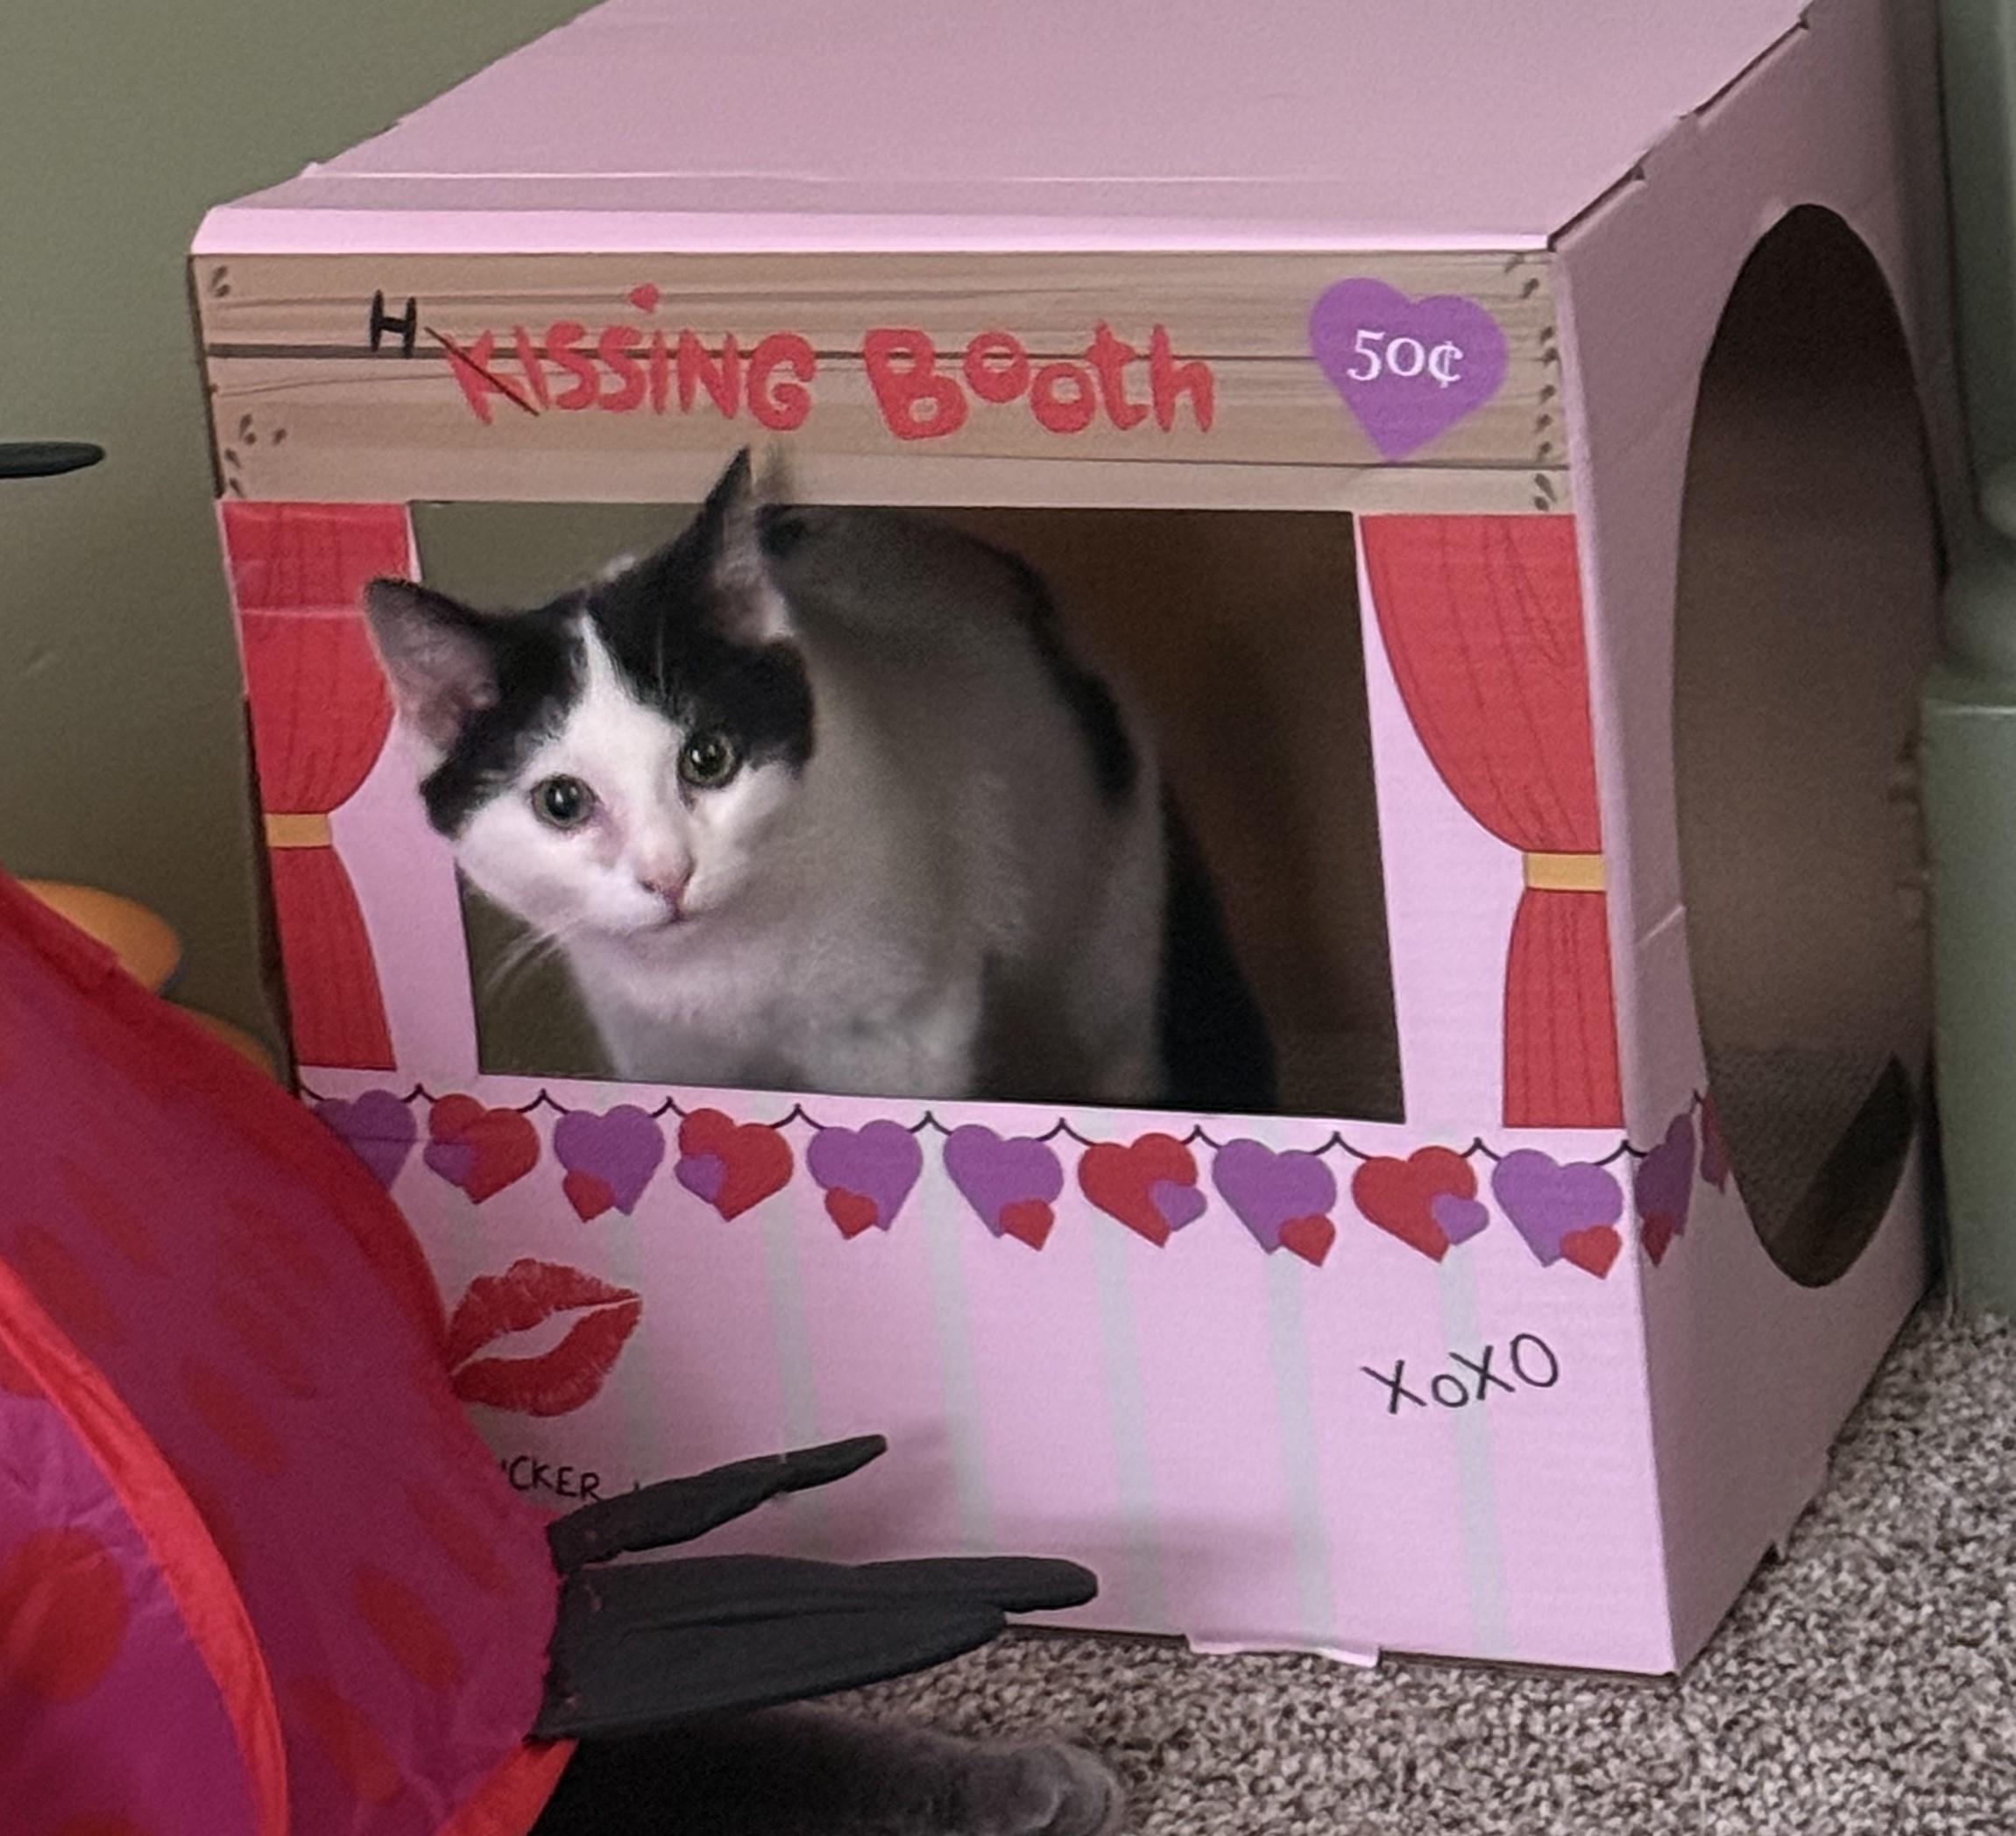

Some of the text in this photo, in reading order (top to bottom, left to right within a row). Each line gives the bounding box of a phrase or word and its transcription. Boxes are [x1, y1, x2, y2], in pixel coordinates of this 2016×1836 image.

[370, 288, 417, 357] H
[863, 319, 1214, 440] Booth
[1347, 328, 1464, 389] 50¢
[501, 1454, 605, 1501] CKER
